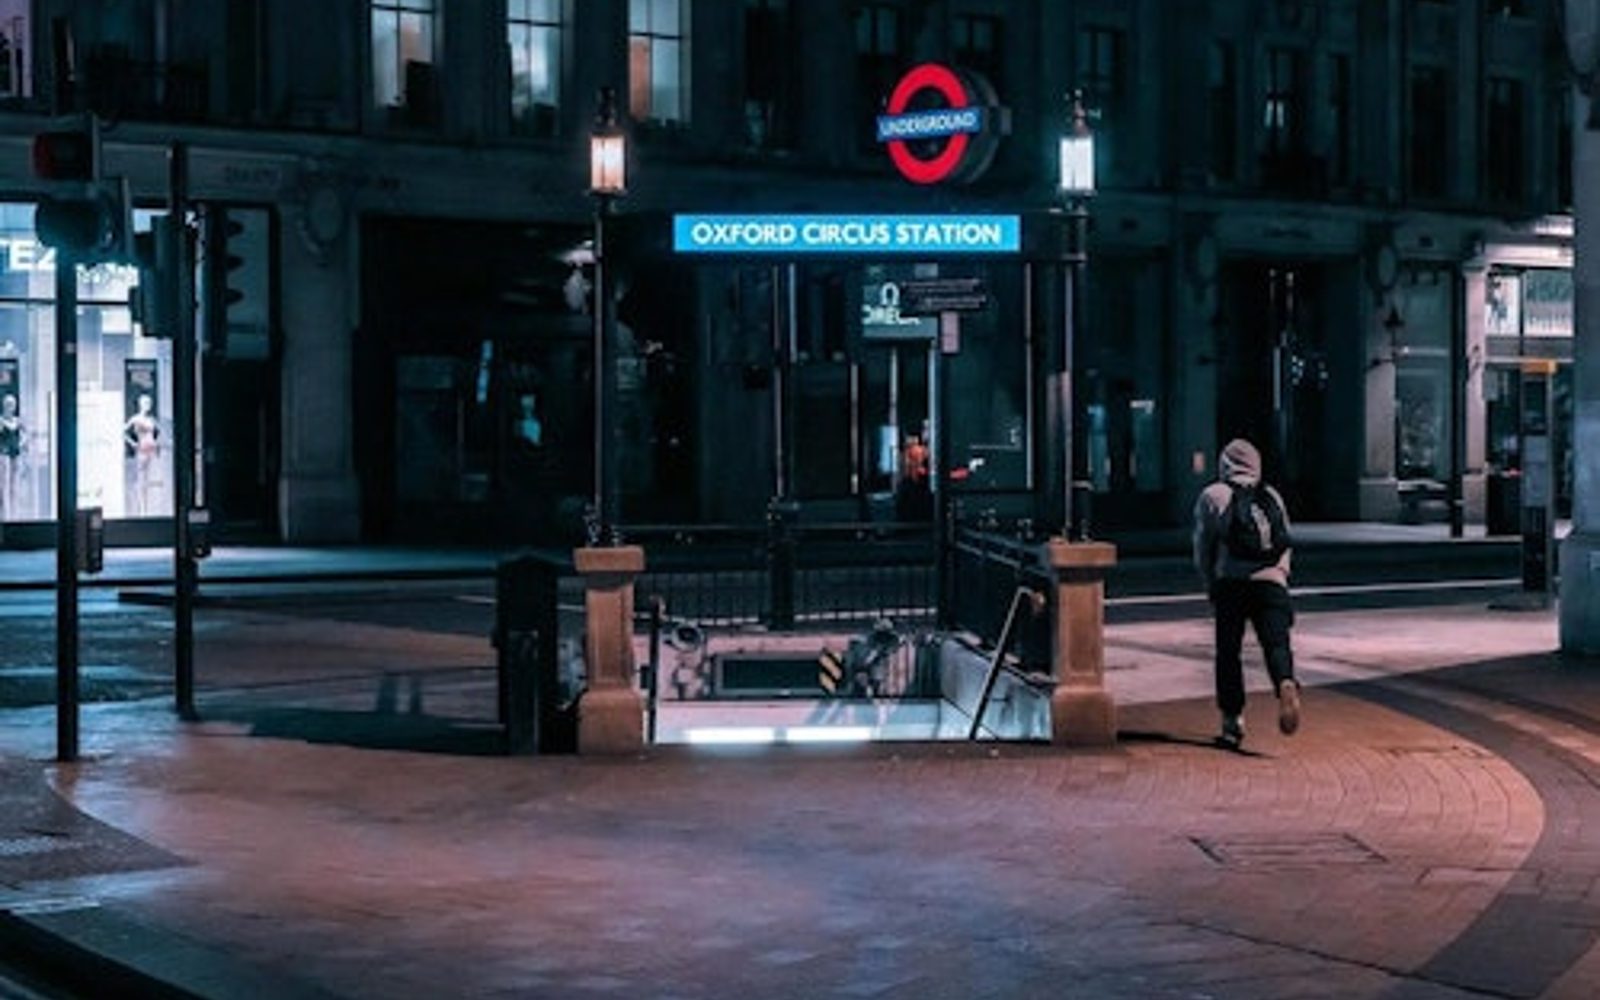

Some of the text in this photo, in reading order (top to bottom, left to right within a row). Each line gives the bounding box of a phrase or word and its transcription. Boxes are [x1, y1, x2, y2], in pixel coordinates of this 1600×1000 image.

[880, 112, 977, 136] UNDERGROUND
[691, 221, 1002, 245] OXFORD CIRCUS STATION
